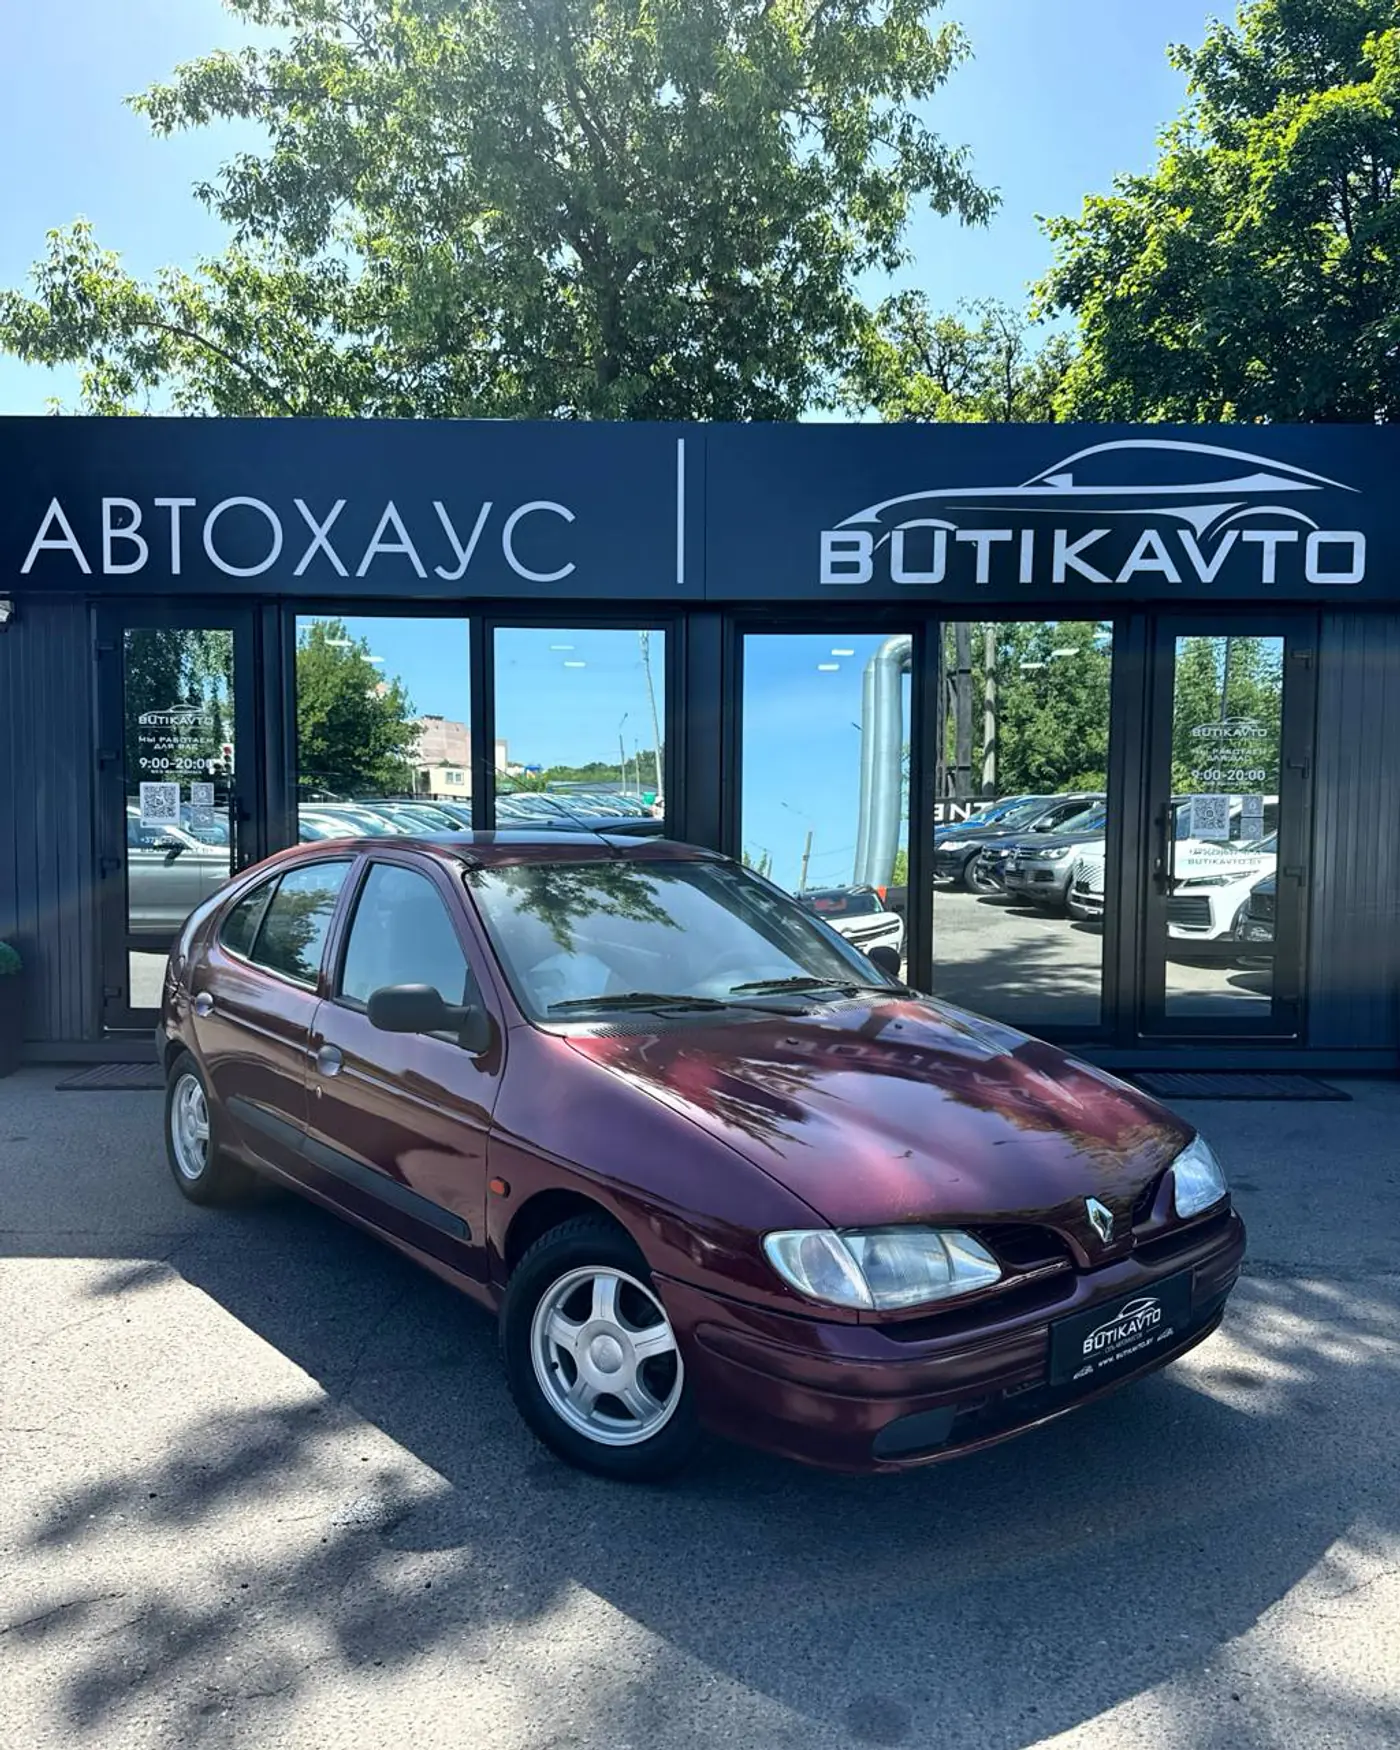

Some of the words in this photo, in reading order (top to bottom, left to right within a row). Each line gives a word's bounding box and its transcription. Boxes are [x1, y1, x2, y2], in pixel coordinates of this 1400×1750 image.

[20, 496, 576, 582] АВТОХАУС
[819, 528, 1366, 585] BUTIKAVTO
[138, 715, 214, 725] BUTIKAVTO
[1192, 728, 1268, 737] BUTIKAVTO
[139, 757, 212, 769] 9:00-20:00
[1083, 1308, 1161, 1354] BUTIKAVTO
